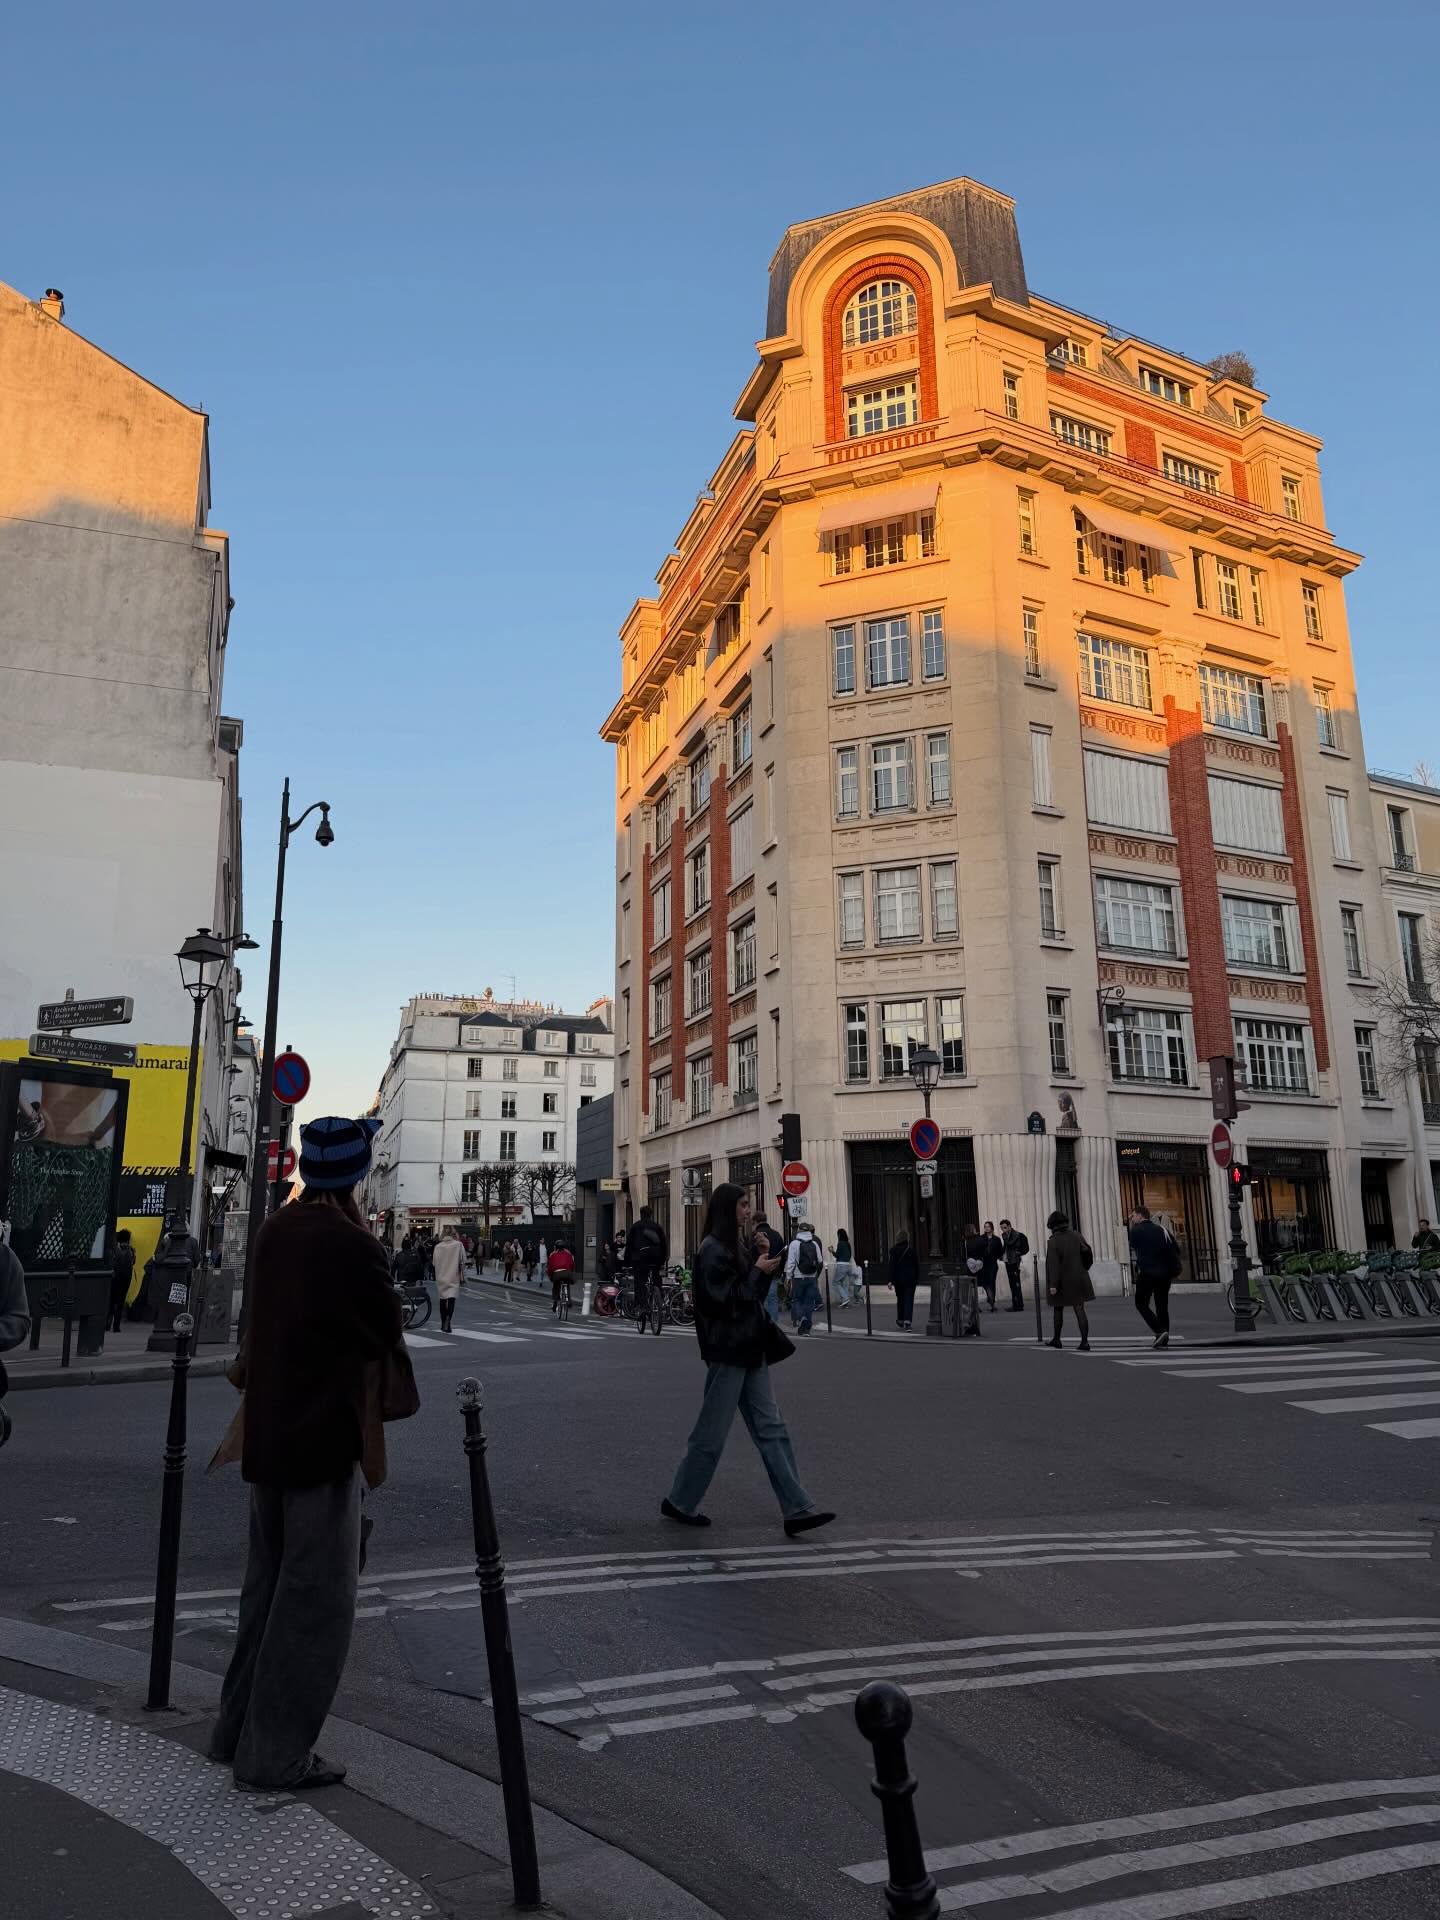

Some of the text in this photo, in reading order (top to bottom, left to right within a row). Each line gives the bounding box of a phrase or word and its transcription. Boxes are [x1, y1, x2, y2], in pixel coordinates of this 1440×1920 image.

[78, 1002, 106, 1010] Nationales
[77, 1042, 107, 1051] PICASSO
[121, 1166, 142, 1176] THE
